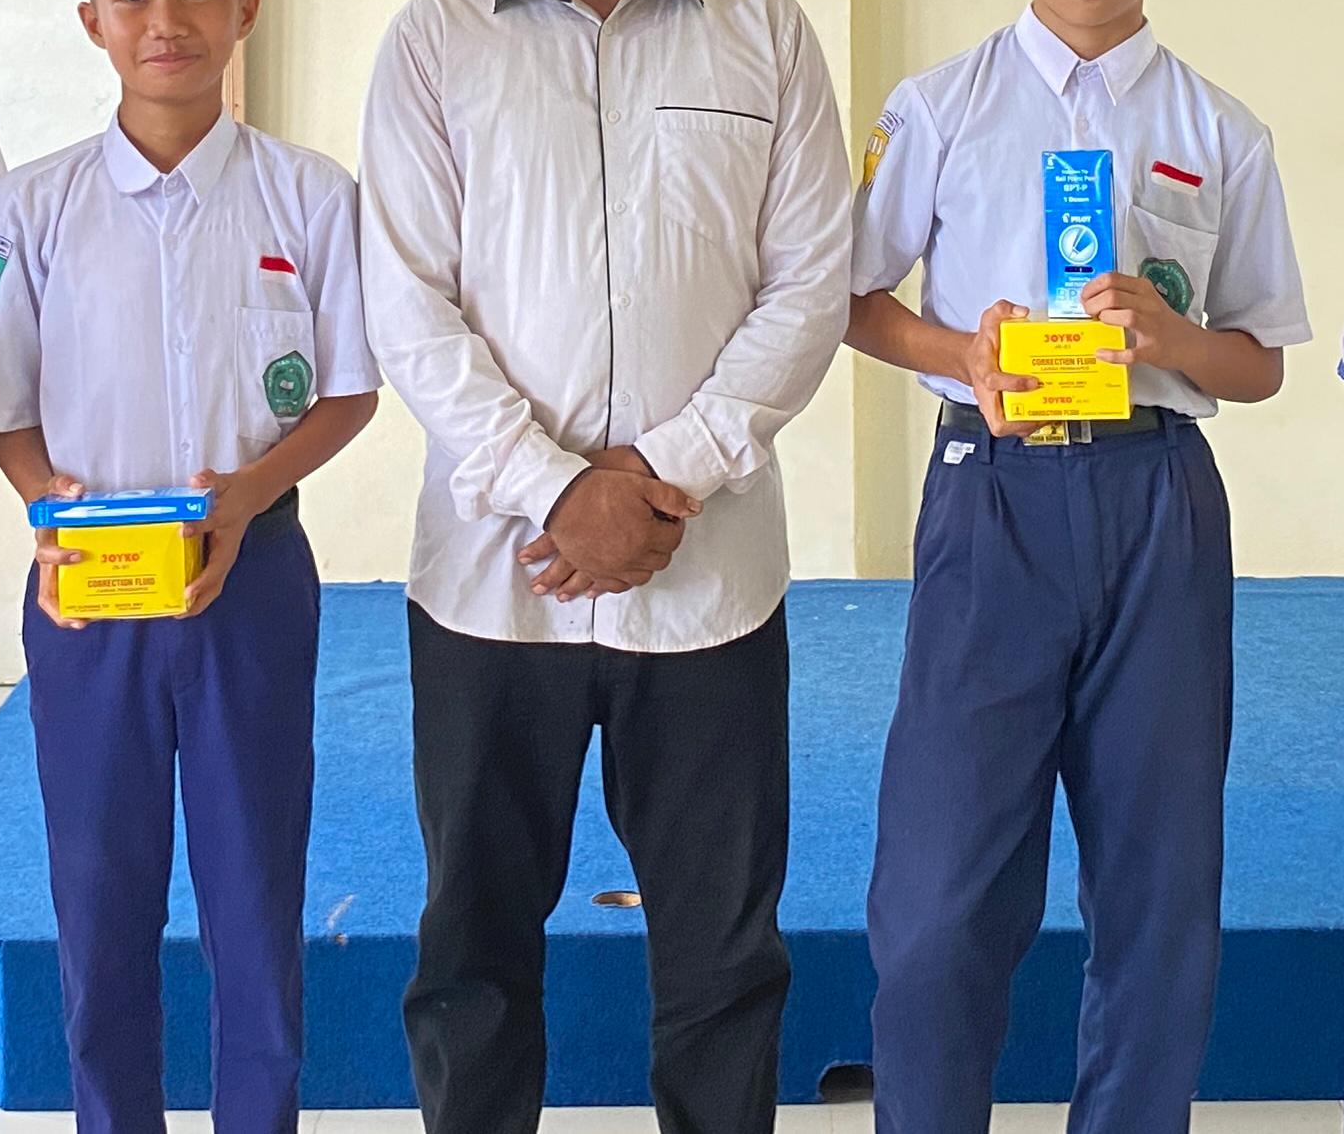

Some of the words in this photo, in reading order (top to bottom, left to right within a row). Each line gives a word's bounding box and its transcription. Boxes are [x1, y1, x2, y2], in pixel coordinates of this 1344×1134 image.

[1070, 215, 1092, 223] PILOT
[1044, 333, 1081, 343] JOYKO
[1031, 357, 1075, 366] CORRECTION
[1042, 396, 1073, 404] JOYKO
[100, 552, 141, 564] JOYKO
[87, 578, 134, 588] CORRECTION
[135, 577, 156, 586] FLUID
